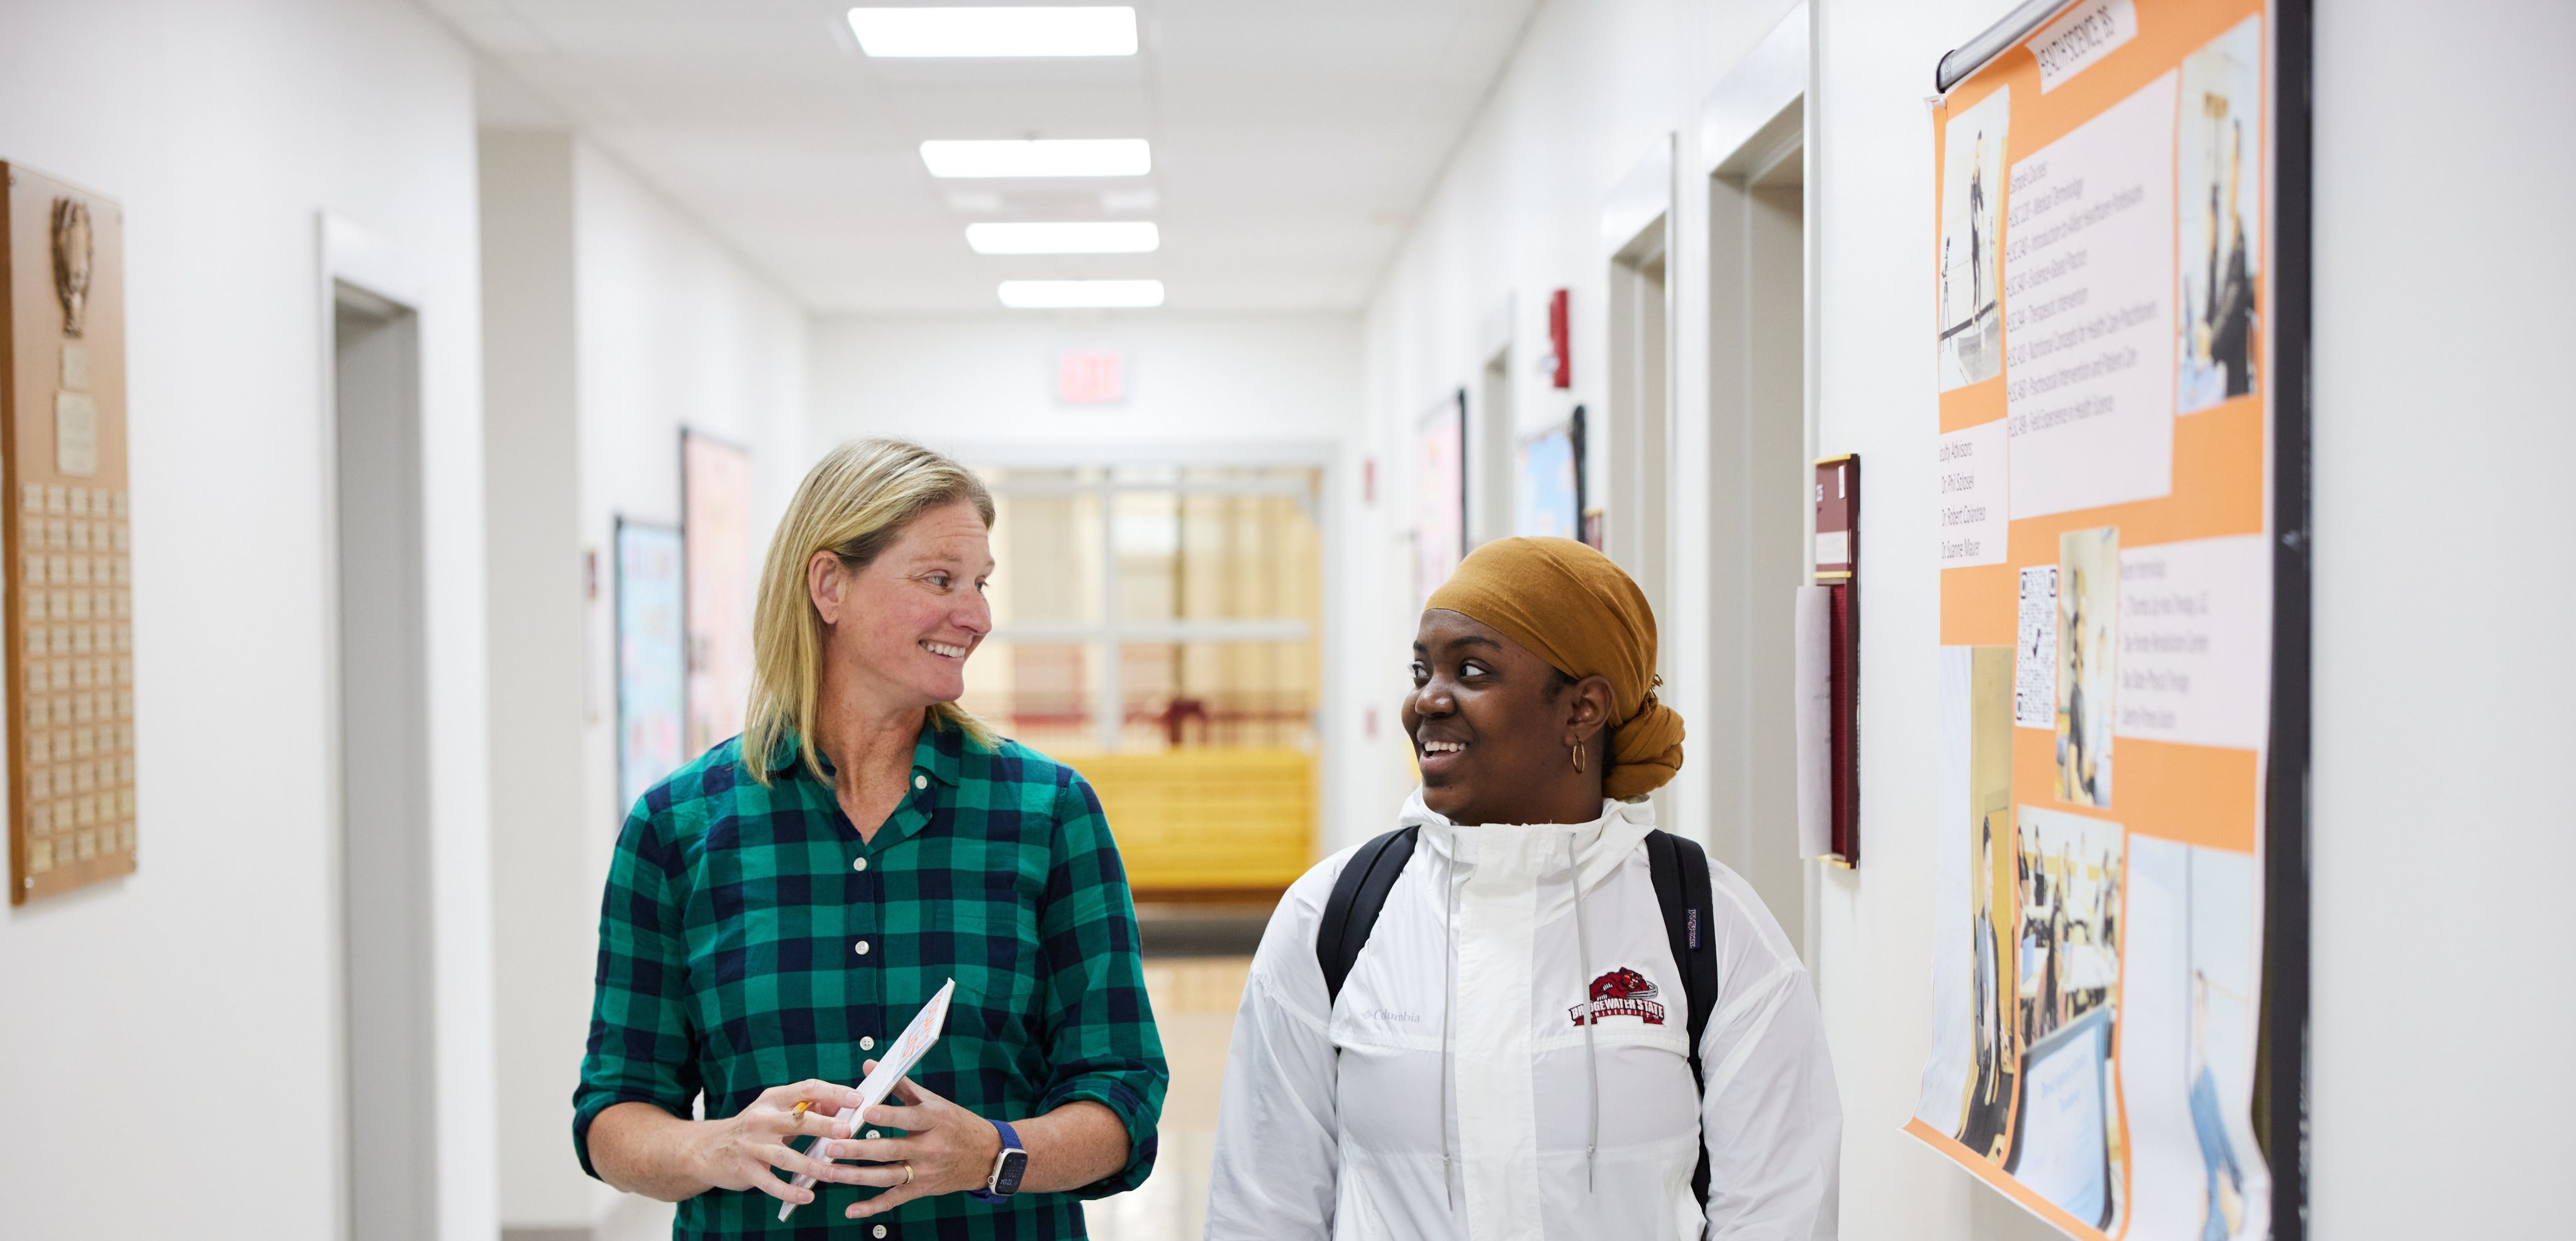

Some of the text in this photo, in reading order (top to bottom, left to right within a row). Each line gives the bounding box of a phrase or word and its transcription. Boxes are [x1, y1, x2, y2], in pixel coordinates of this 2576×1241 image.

[2036, 38, 2068, 78] HEALTH
[2097, 6, 2114, 36] BS
[1948, 505, 1962, 526] Robert
[1374, 1008, 1420, 1023] Columbia
[1572, 998, 1664, 1020] BRDGEWATER STATE
[1591, 1008, 1650, 1018] NIVERSITY
